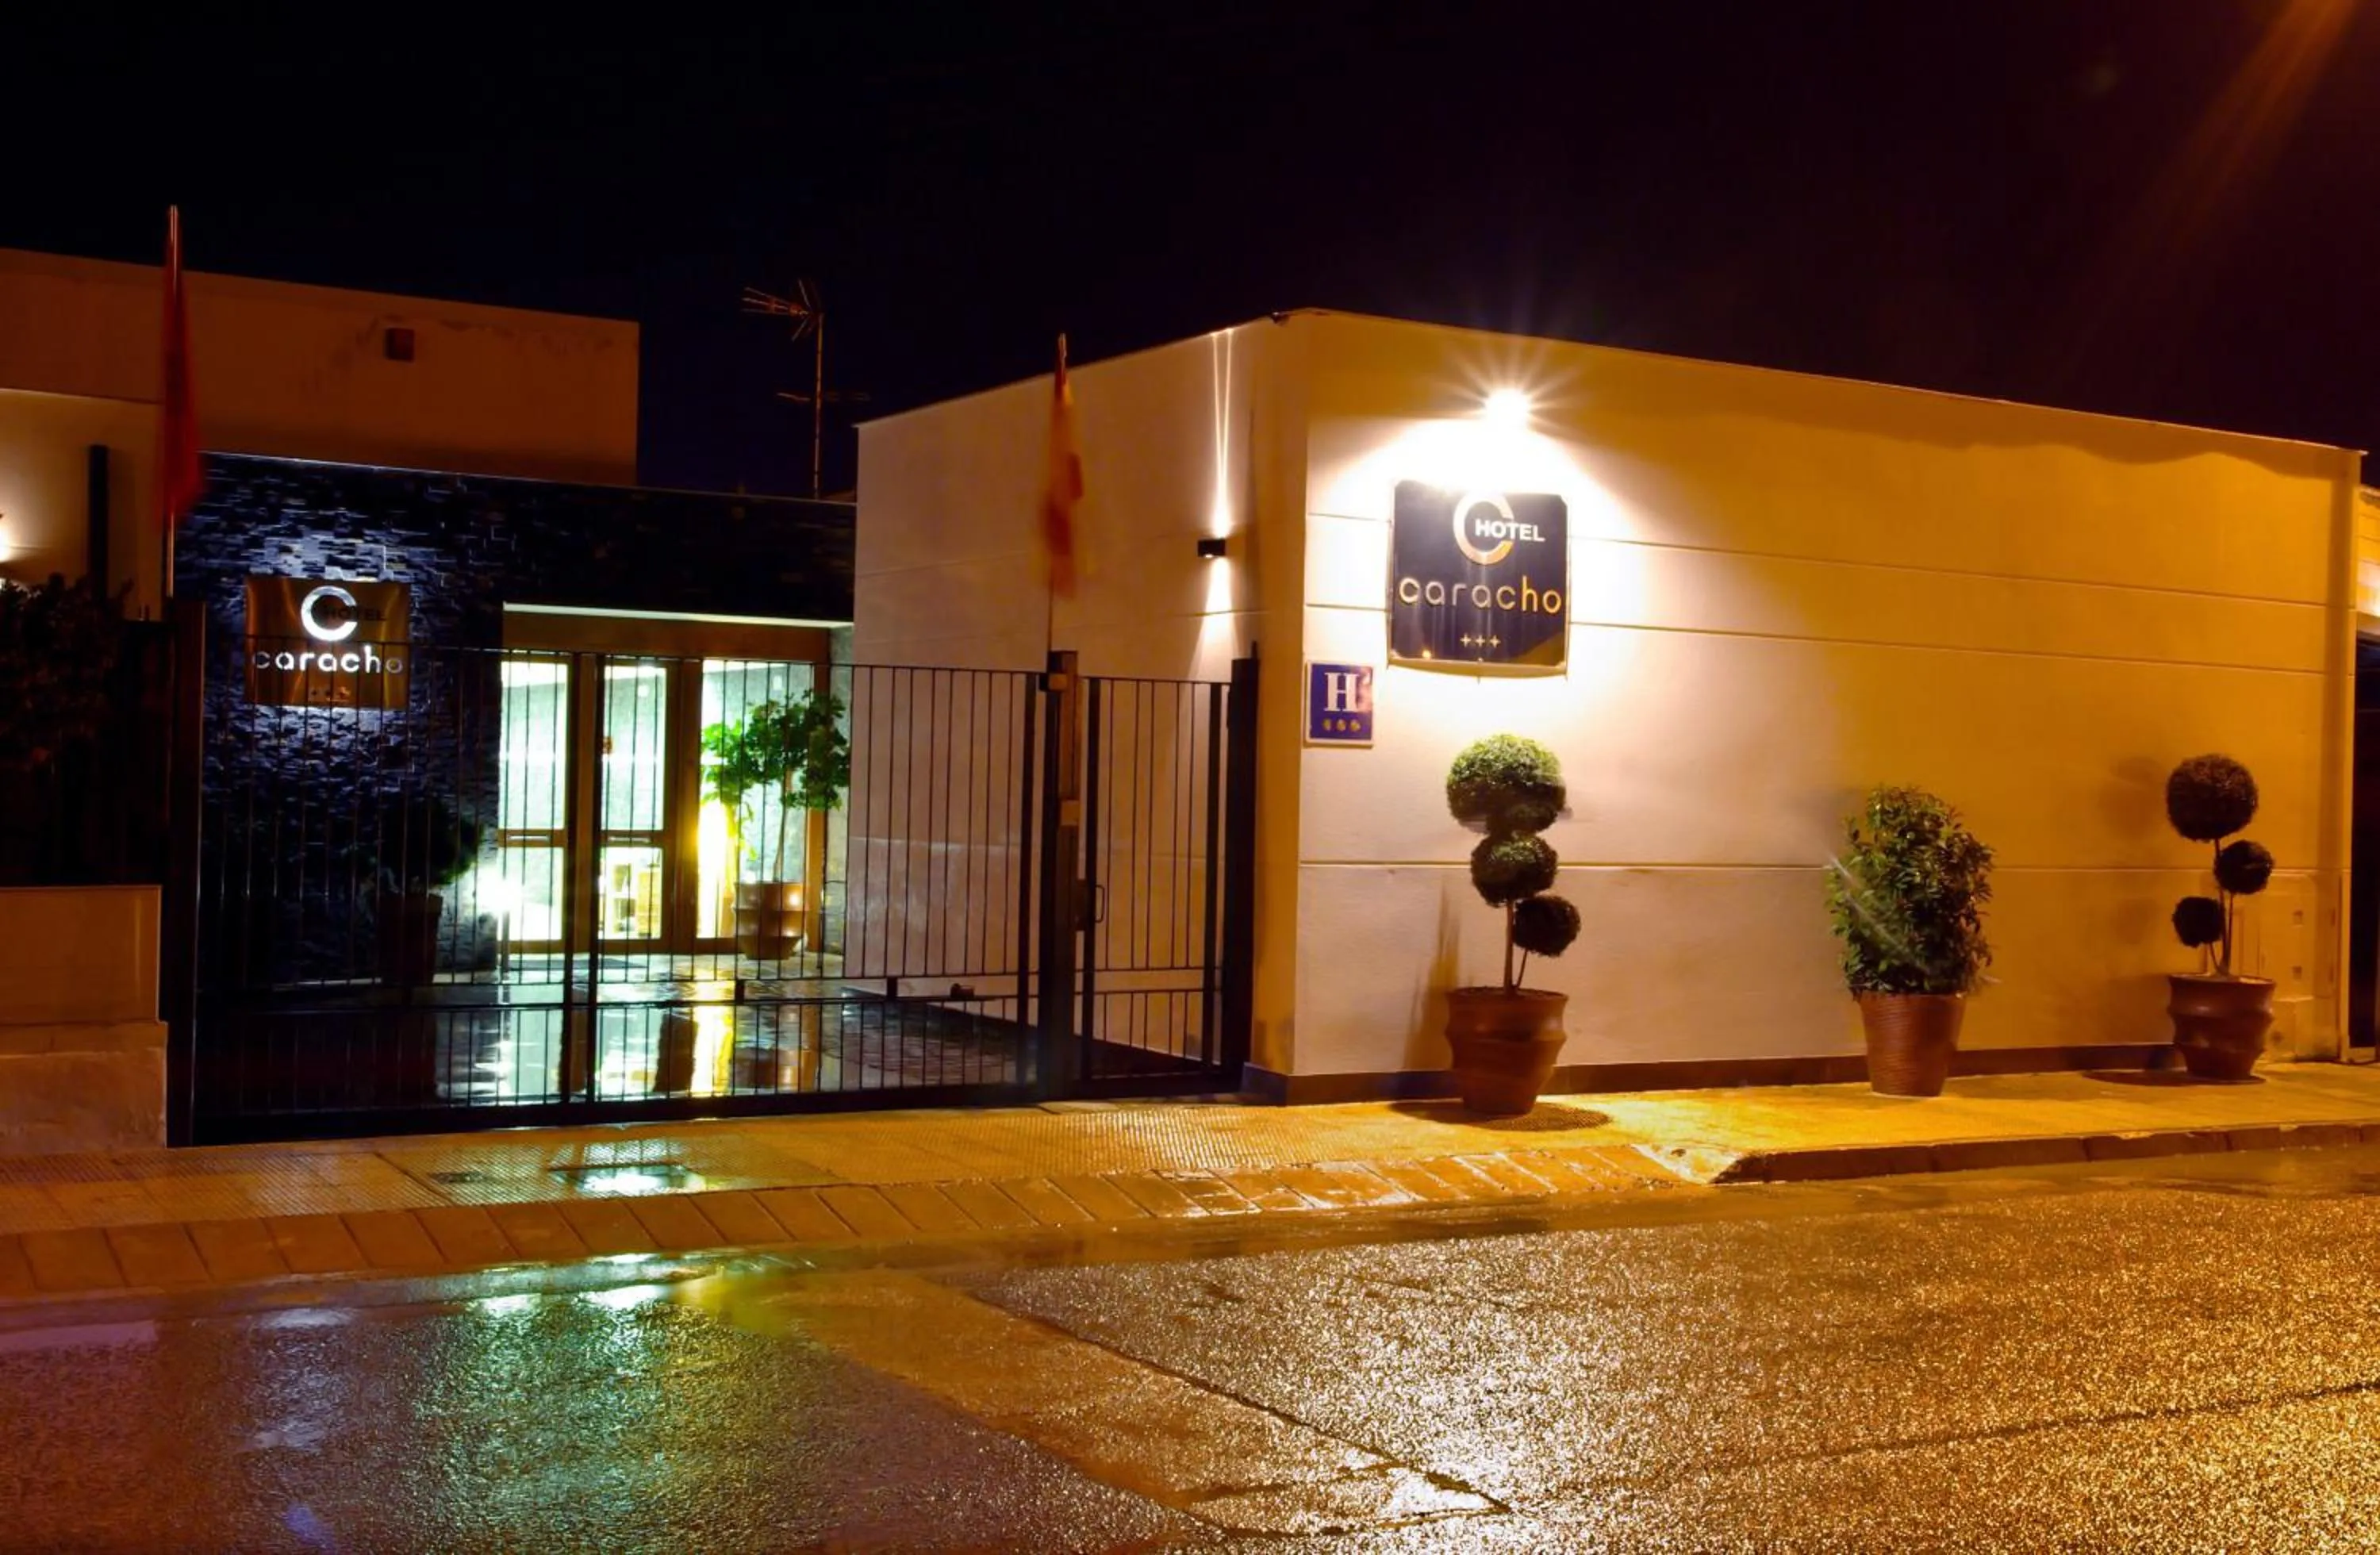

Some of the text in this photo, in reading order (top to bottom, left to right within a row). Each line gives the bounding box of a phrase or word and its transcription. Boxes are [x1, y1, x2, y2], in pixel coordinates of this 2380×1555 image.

[1475, 518, 1545, 543] HOTEL
[1399, 575, 1561, 614] caracho
[252, 644, 402, 674] caracho
[1323, 672, 1359, 712] H
